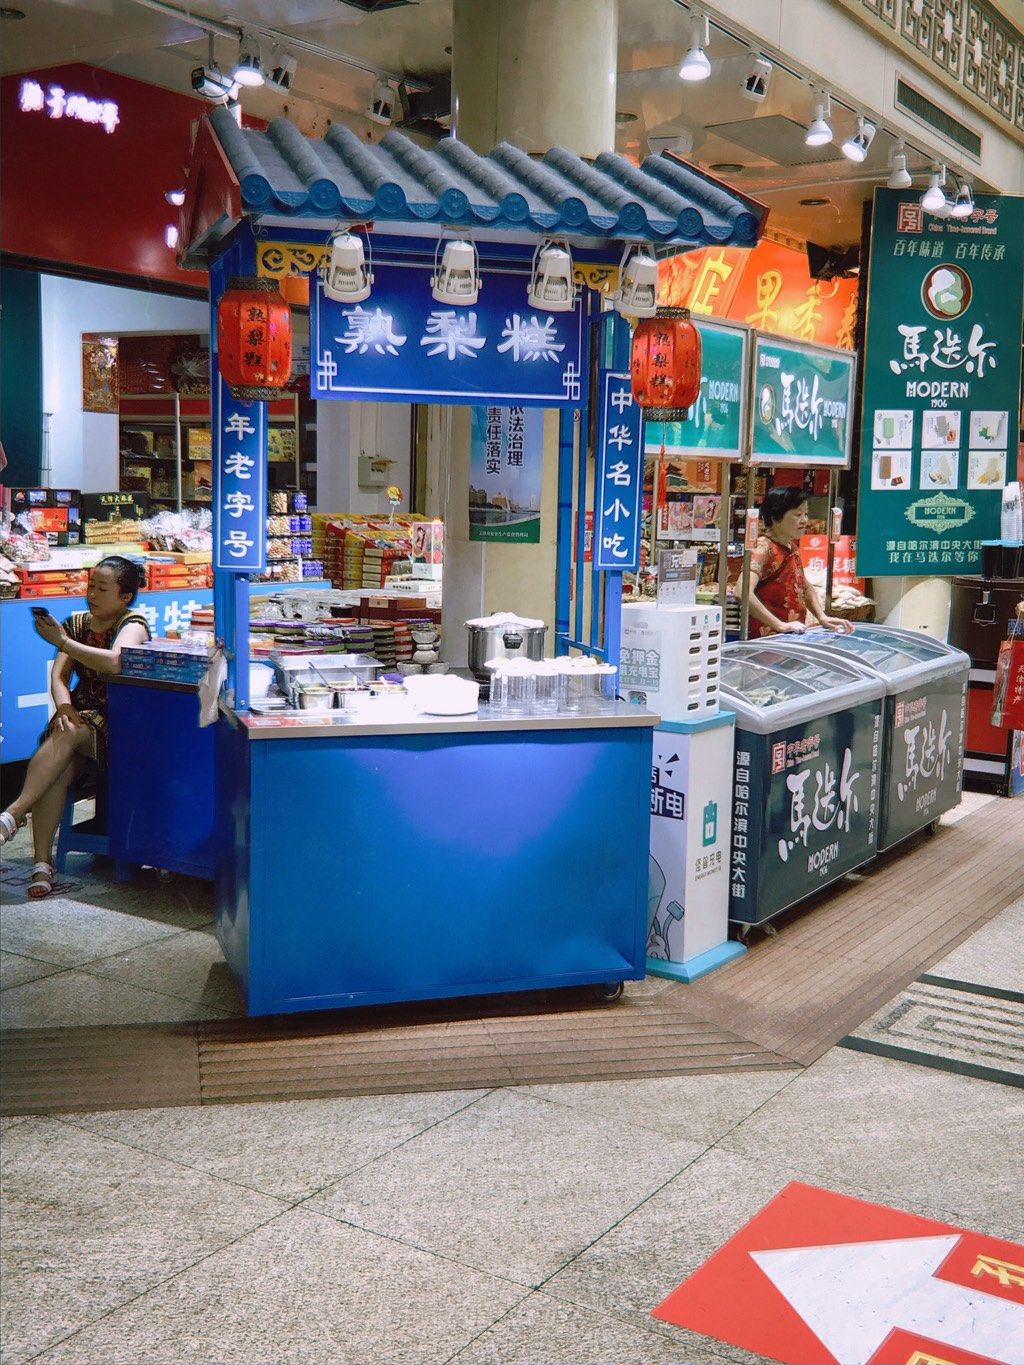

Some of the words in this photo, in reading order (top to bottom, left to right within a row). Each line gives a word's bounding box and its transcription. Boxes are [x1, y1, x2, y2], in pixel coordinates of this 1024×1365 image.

[893, 239, 944, 257] 百年味道
[955, 243, 1006, 260] 百年传承
[334, 306, 566, 363] 熟梨糕
[708, 381, 739, 402] MODERN
[906, 381, 969, 398] MODERN
[823, 400, 846, 418] MODERN
[930, 399, 948, 408] 1906
[486, 407, 502, 475] 责任落实
[603, 388, 633, 558] 中华名小吃
[924, 507, 957, 515] MODERN
[731, 751, 751, 898] 源自哈尔滨中央大街
[807, 841, 839, 873] MODERN
